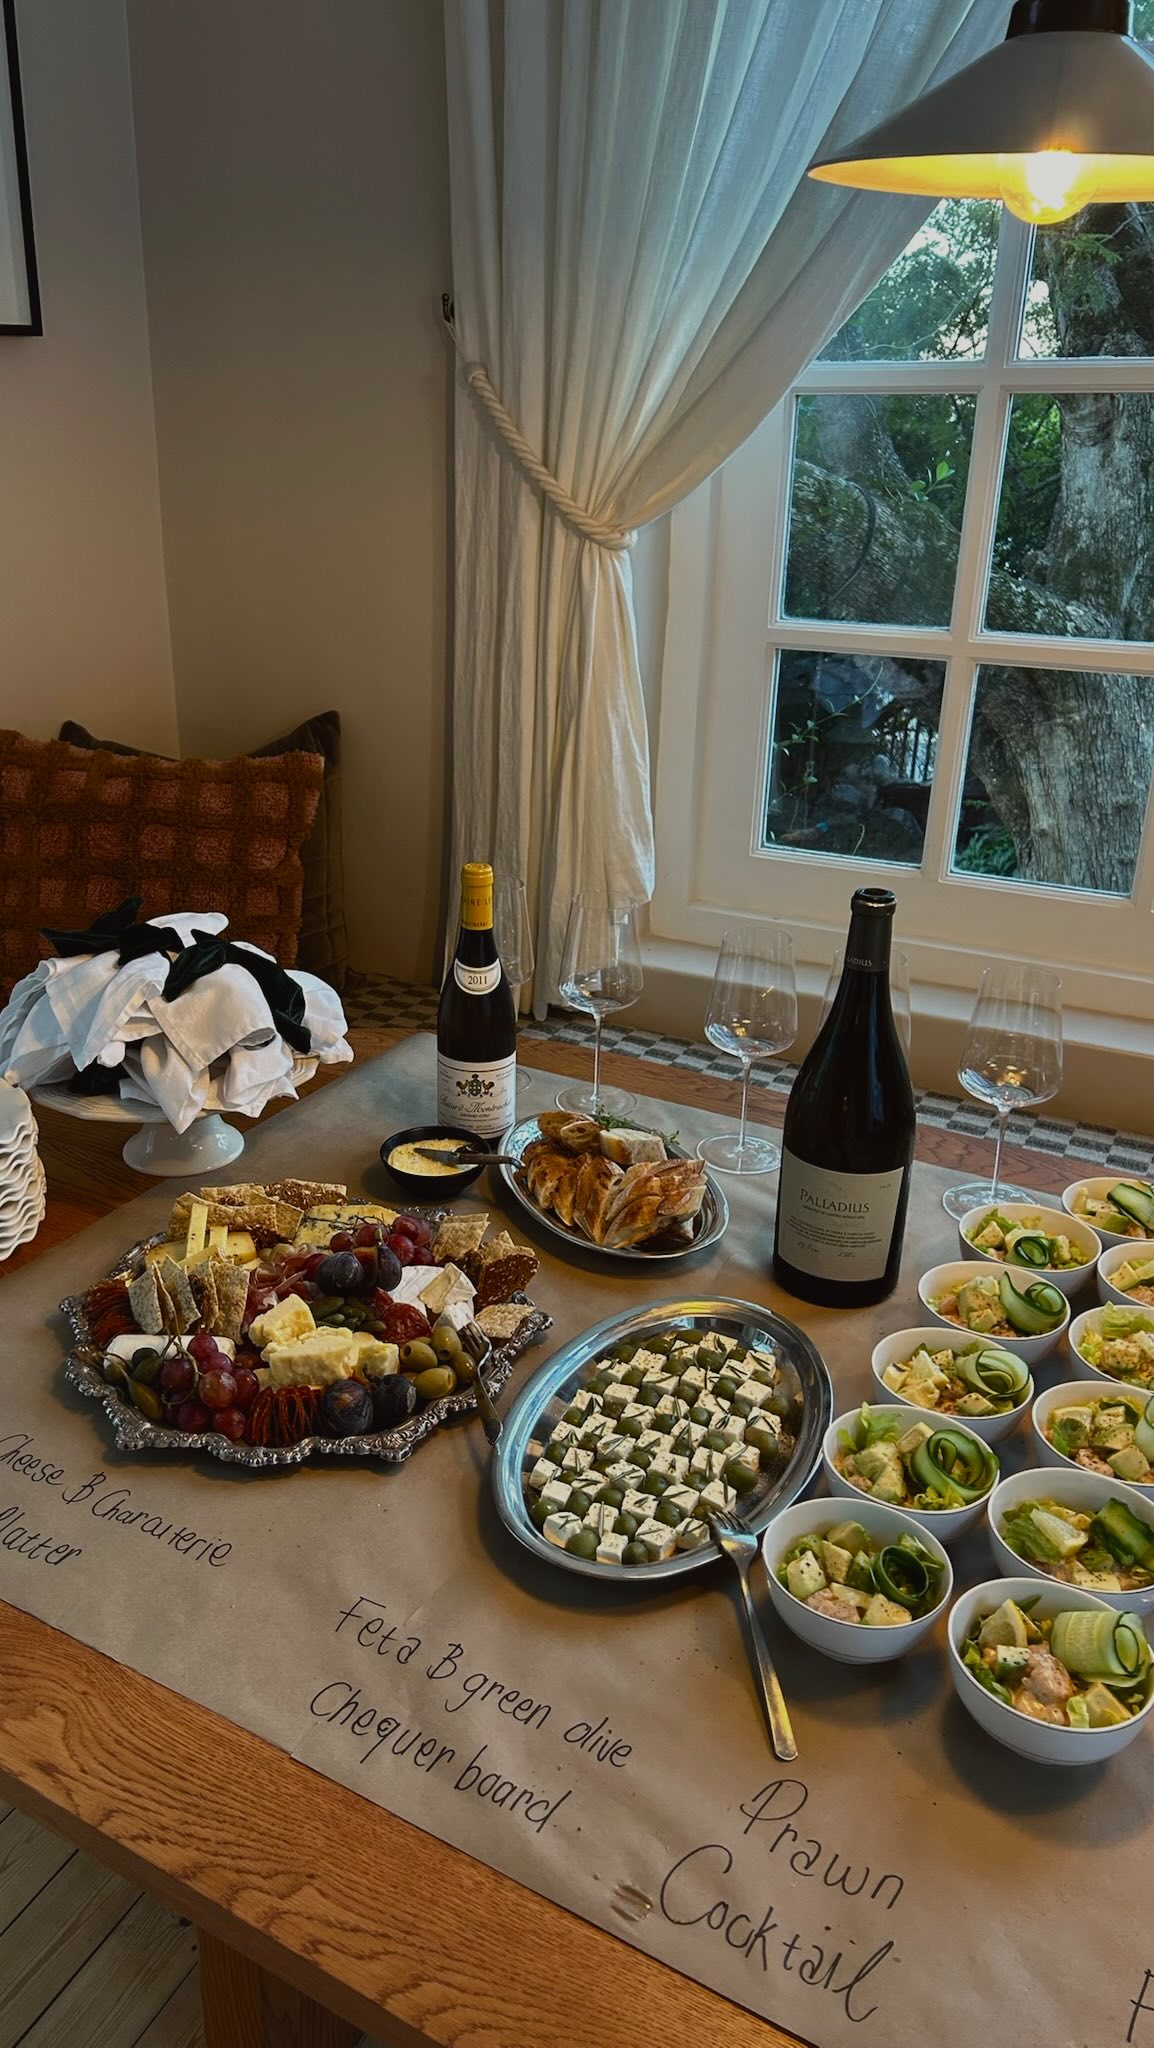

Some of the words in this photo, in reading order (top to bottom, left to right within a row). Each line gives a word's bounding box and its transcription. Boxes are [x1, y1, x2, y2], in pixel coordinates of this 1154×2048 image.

[468, 975, 488, 985] 2011
[800, 1188, 870, 1213] PALLADIUS
[0, 1433, 65, 1486] Cheese
[335, 1596, 422, 1664] Feta
[444, 1673, 552, 1730] green
[563, 1717, 632, 1768] olive
[310, 1681, 456, 1773] Chequer
[453, 1744, 573, 1833] board
[739, 1779, 904, 1910] Prawn
[660, 1844, 895, 2022] Cocktail
